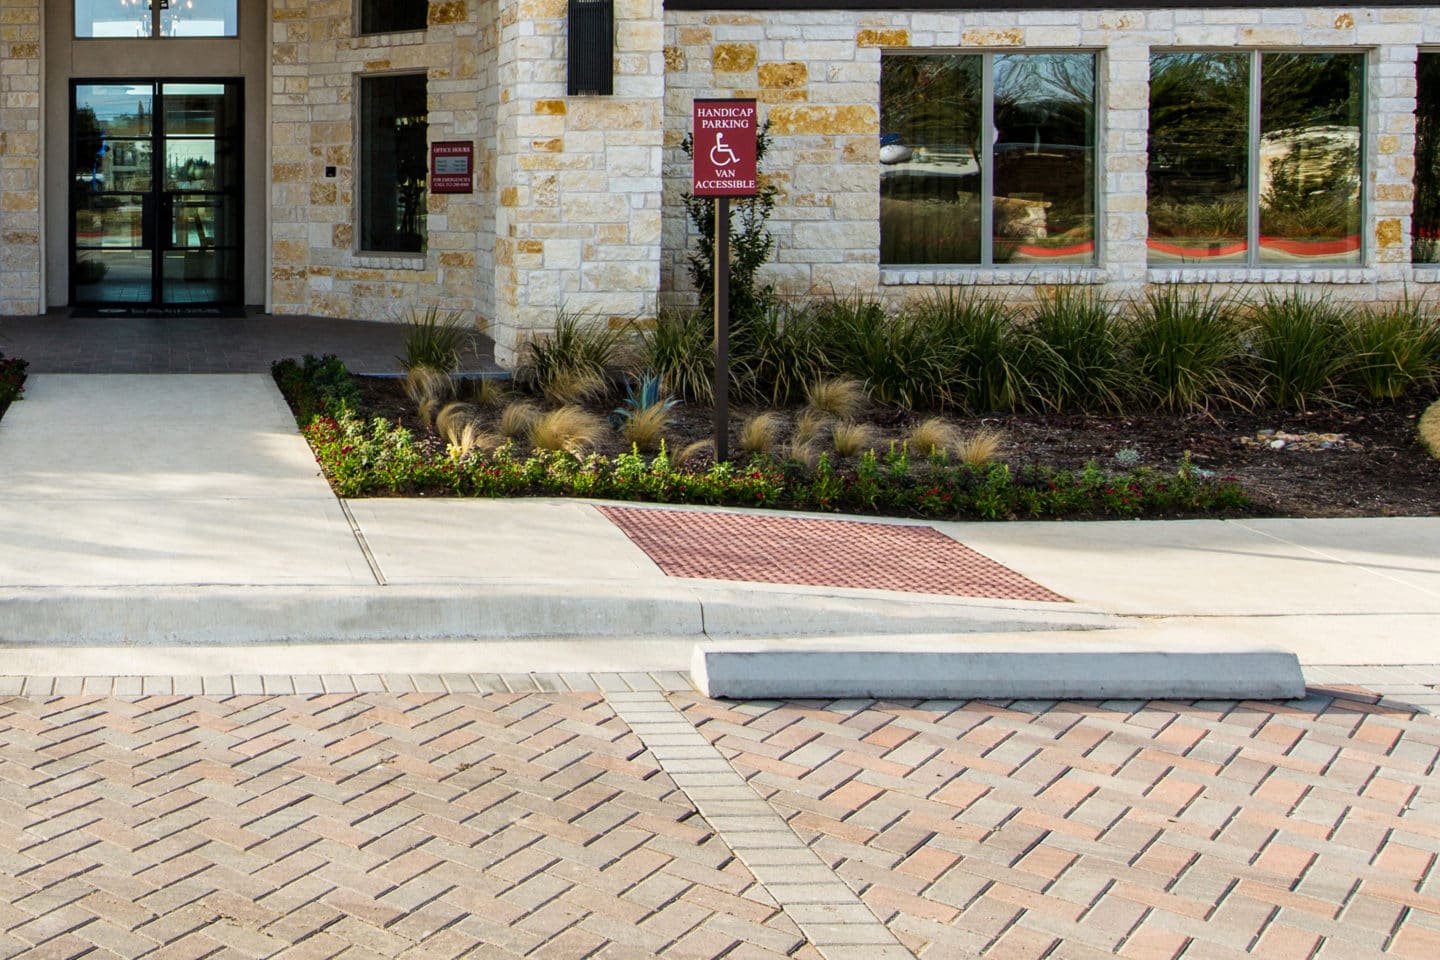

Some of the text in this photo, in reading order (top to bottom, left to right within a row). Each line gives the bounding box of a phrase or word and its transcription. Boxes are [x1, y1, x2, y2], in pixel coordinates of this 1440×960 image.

[697, 108, 754, 117] HANDICAP
[702, 119, 749, 129] PARKING
[715, 169, 736, 178] VAN
[695, 180, 755, 189] ACCESSIBLE
